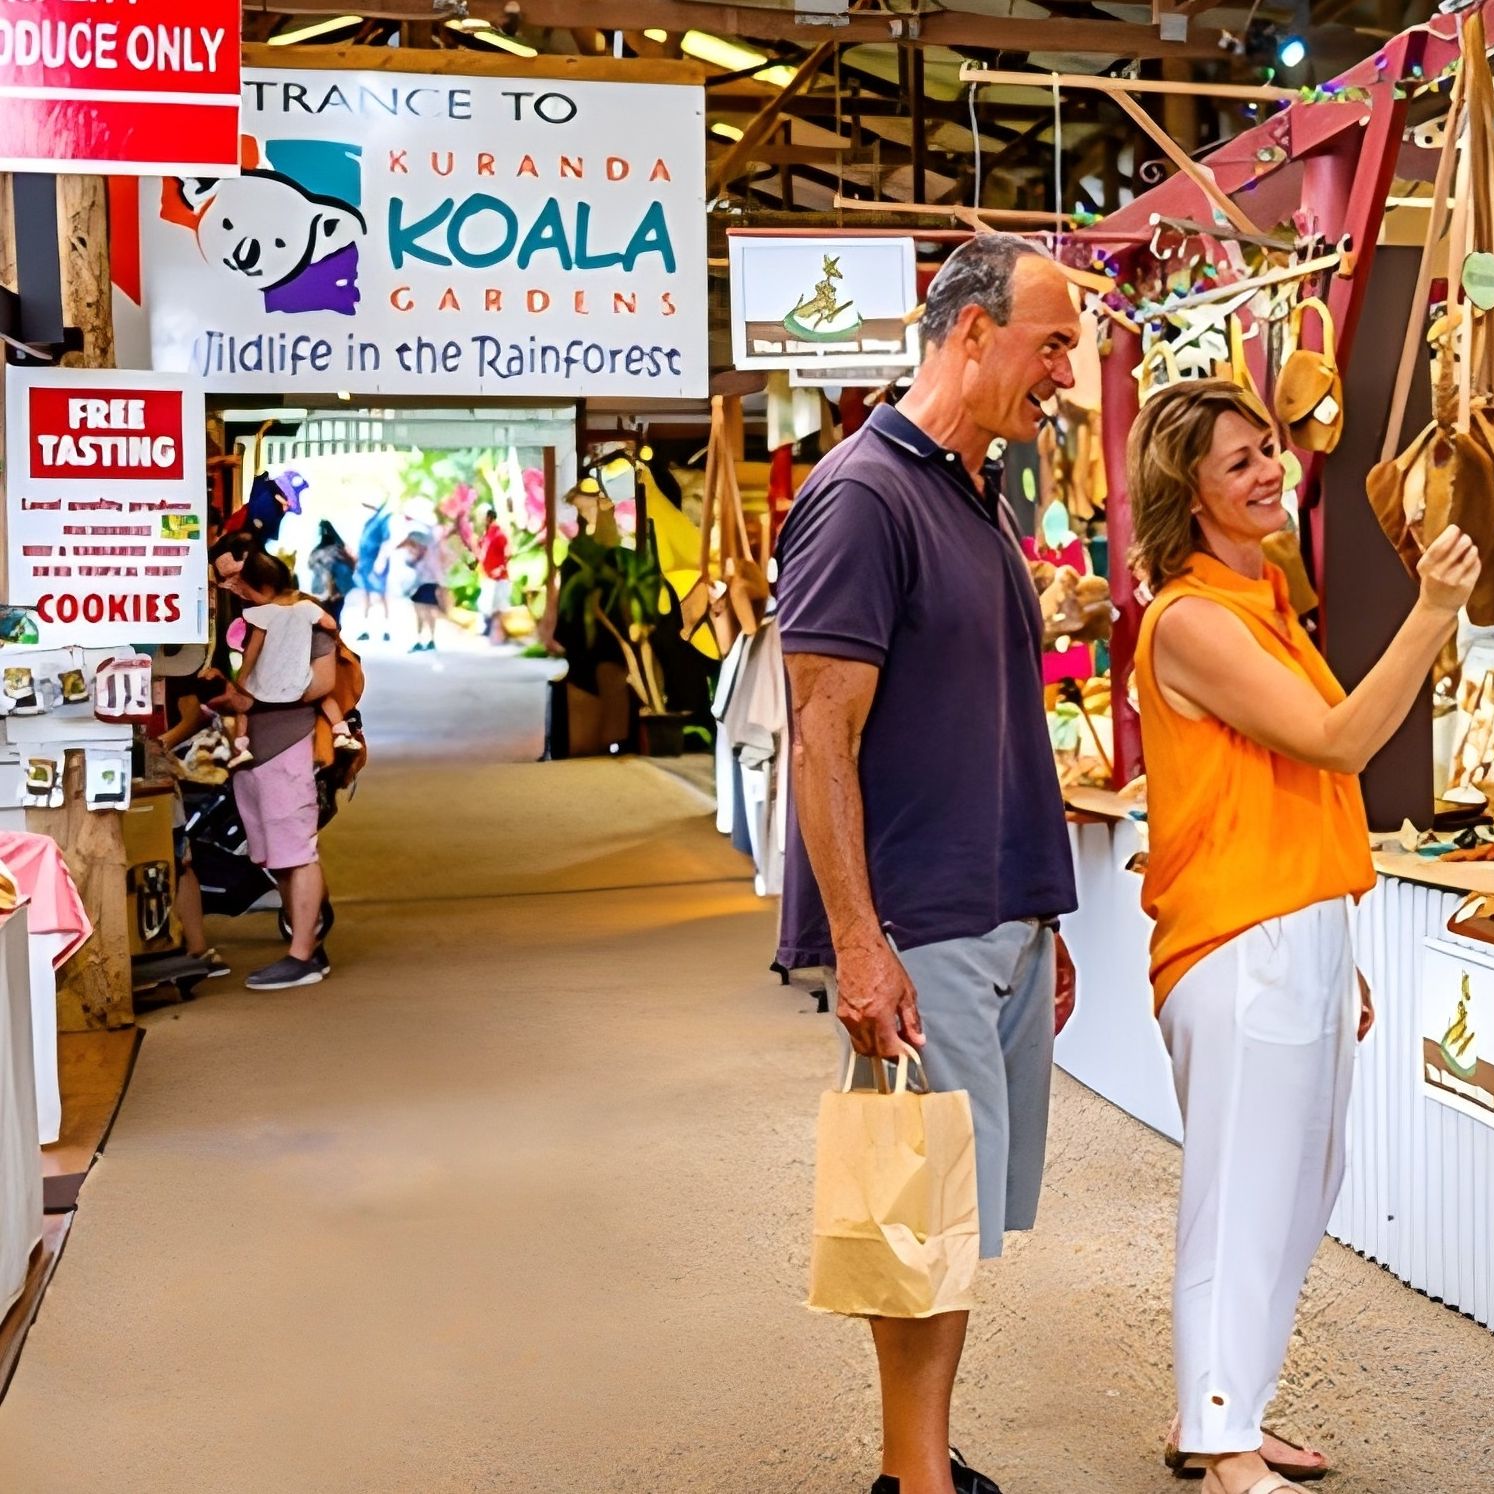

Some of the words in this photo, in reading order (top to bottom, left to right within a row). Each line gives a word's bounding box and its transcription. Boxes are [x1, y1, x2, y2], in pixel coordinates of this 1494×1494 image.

[126, 24, 225, 73] ONLY
[501, 90, 578, 124] TO
[389, 150, 671, 182] KURANDA
[388, 192, 677, 274] KOALA
[347, 333, 380, 371] in
[396, 335, 462, 374] the
[471, 334, 682, 379] Rainforest
[68, 397, 146, 430] FREE
[37, 434, 176, 468] TASTING
[37, 593, 181, 624] COOKIES
